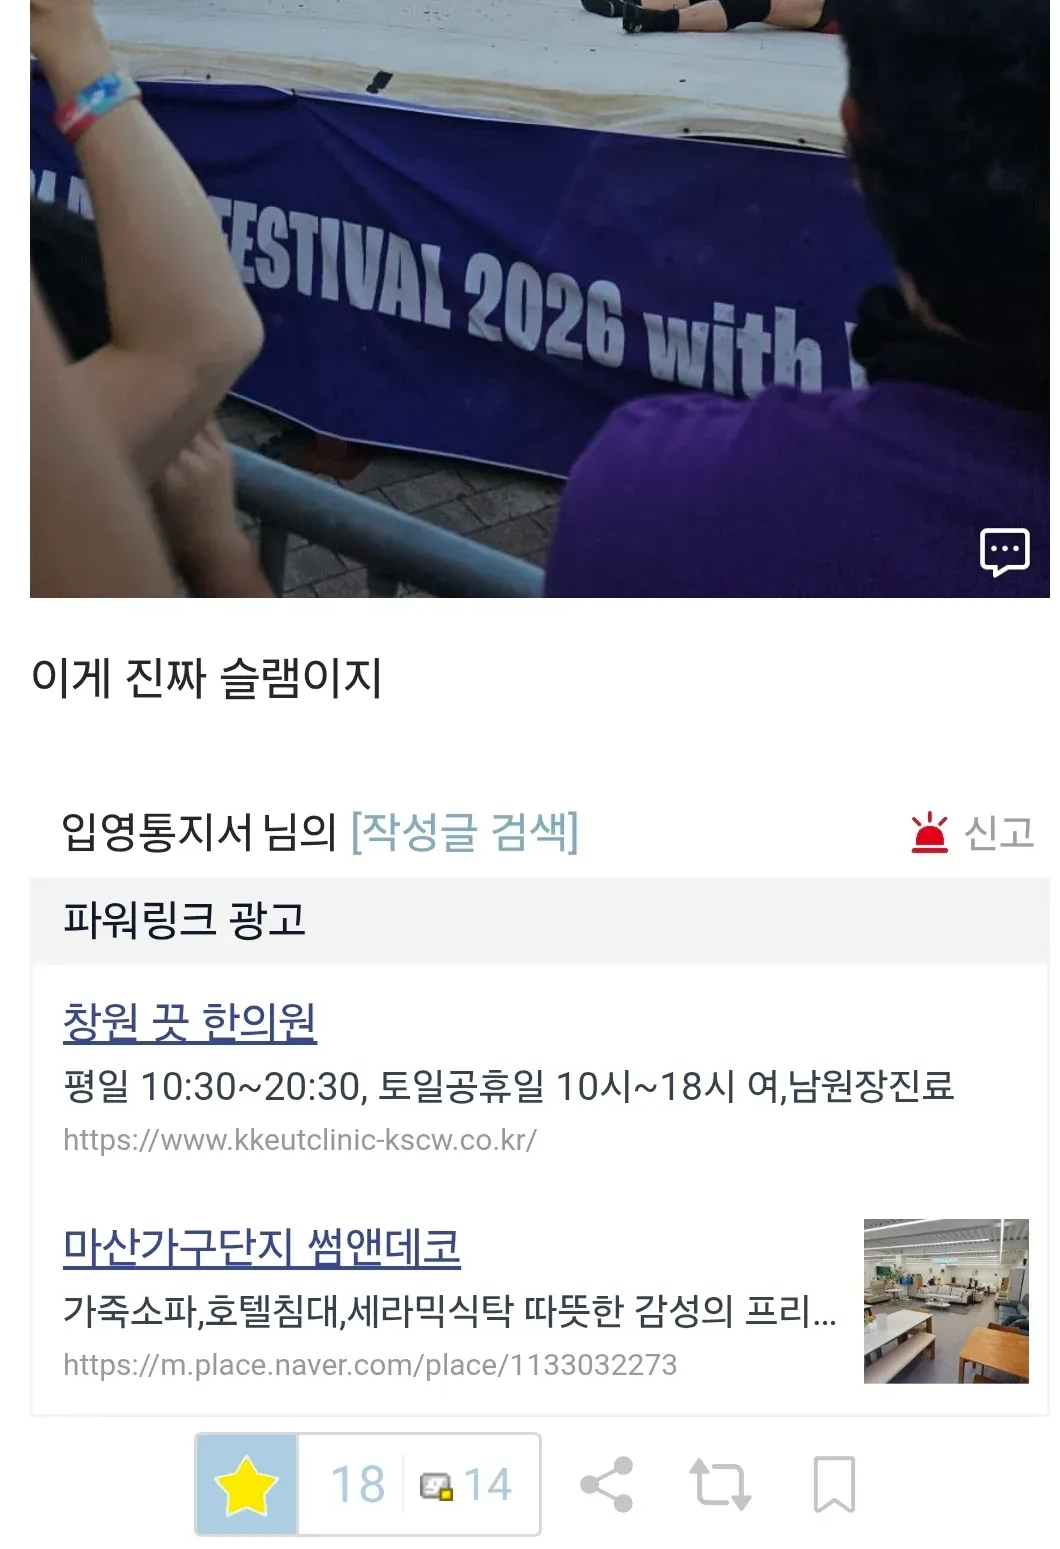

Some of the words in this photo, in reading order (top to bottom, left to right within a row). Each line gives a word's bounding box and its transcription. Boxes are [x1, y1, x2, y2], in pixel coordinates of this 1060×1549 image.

[464, 252, 625, 368] 2026
[643, 282, 823, 399] with
[32, 657, 110, 700] 이게
[125, 657, 208, 700] 진짜
[220, 656, 380, 701] 슬램이지
[62, 812, 252, 854] 입영통지서
[352, 810, 478, 856] [작성글
[491, 810, 578, 856] 검색]
[964, 814, 1035, 851] 신고
[63, 900, 217, 941] 파워링크
[229, 900, 306, 941] 광고
[63, 1002, 138, 1042] 창원
[151, 1003, 189, 1042] 끗
[202, 1002, 317, 1042] 한의원
[64, 1068, 128, 1104] 평일
[142, 1071, 368, 1107] 10:30~20:30,
[378, 1069, 544, 1105] 토일공휴일
[557, 1069, 734, 1104] 10시~18시
[748, 1068, 955, 1107] 여,남원장진료
[64, 1127, 538, 1157] https://www.kkeutclinic-kscw.co.kr/
[63, 1227, 293, 1267] 마산가구단지
[307, 1227, 461, 1267] 썸앤데코
[63, 1293, 515, 1332] 가죽소파,호텔침대,세라믹식탁
[525, 1294, 625, 1329] 따뜻한
[634, 1293, 733, 1329] 감성의
[64, 1352, 677, 1382] https://m.place.naver.com/place/1133032273
[332, 1464, 385, 1504] 18
[465, 1467, 512, 1501] 14
